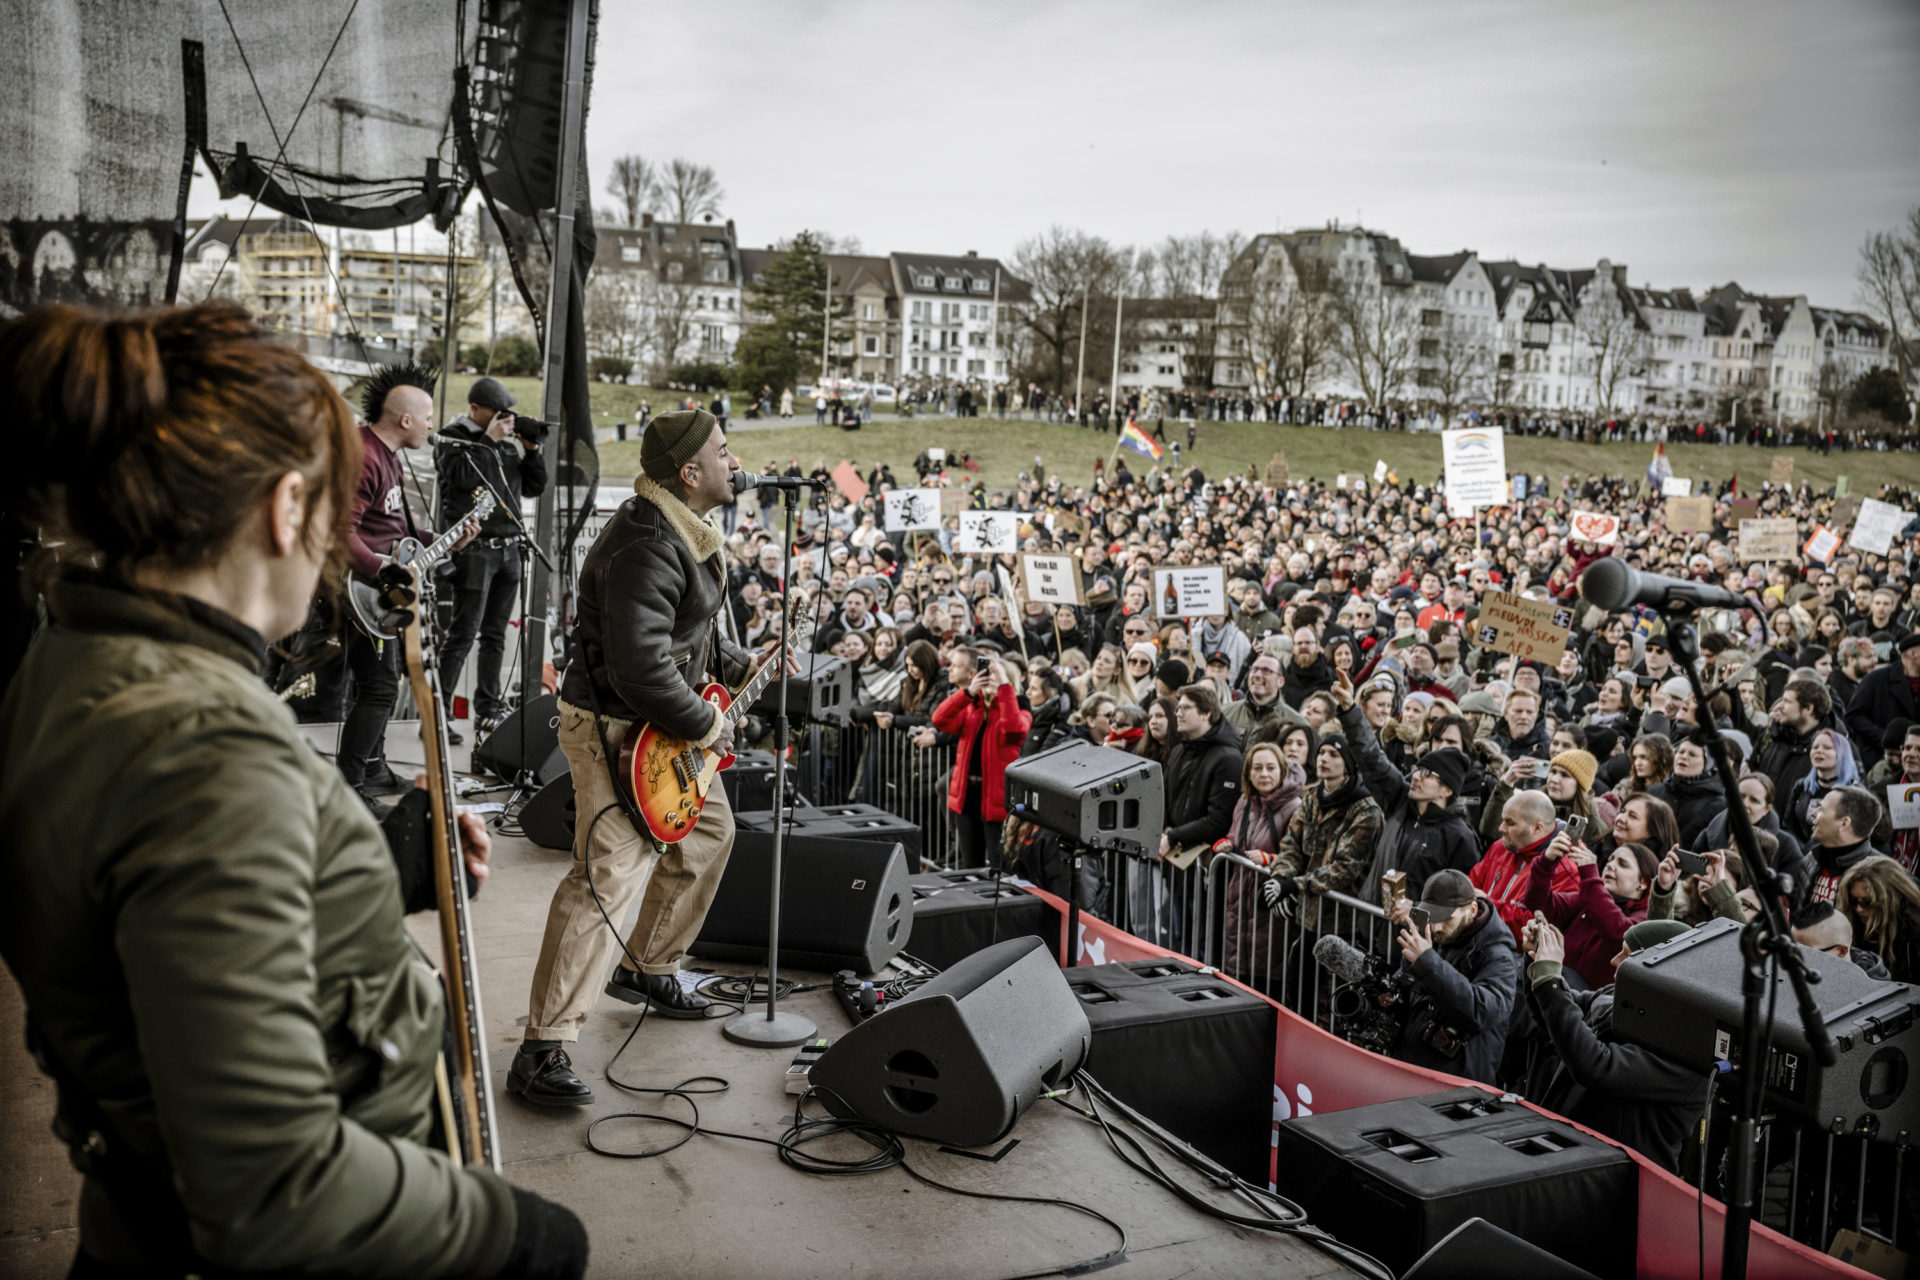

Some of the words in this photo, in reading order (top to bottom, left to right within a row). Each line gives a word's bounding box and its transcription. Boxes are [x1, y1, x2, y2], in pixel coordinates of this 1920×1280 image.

[1040, 586, 1058, 596] Nazis
[1493, 591, 1521, 607] ALLE
[1487, 607, 1536, 628] FREUNDE
[1516, 626, 1560, 644] HASSEN
[1719, 1039, 1728, 1055] TON
